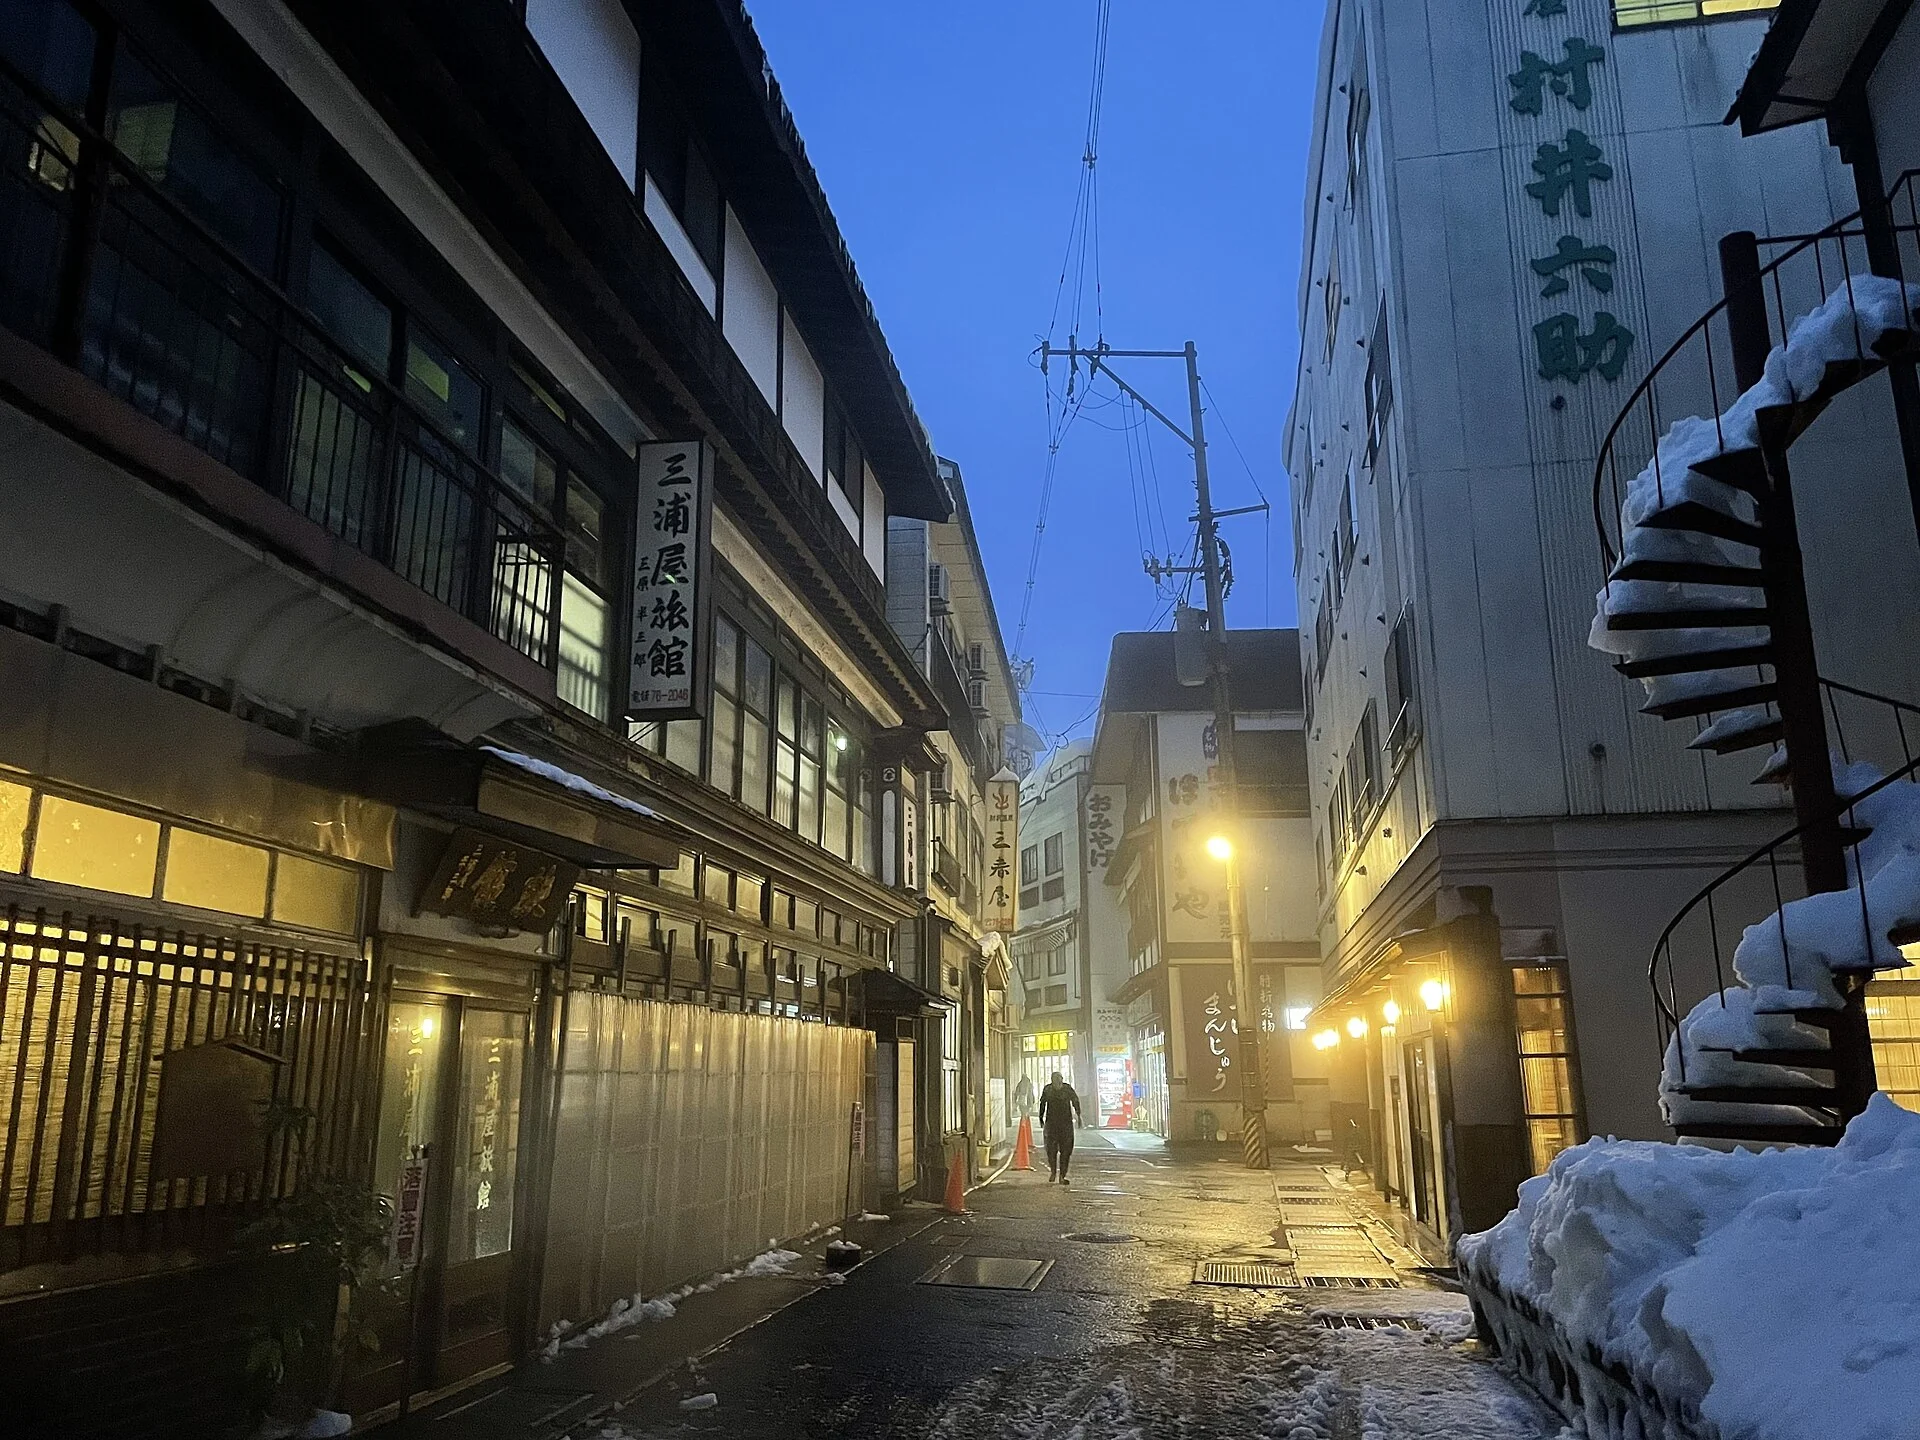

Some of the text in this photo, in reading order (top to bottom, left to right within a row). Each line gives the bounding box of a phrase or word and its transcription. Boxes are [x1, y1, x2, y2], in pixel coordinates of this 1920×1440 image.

[1508, 0, 1635, 383] 村井六助
[648, 453, 691, 679] 三浦屋旅館
[988, 831, 1011, 907] 三春屋
[1203, 992, 1230, 1092] まんじゅう
